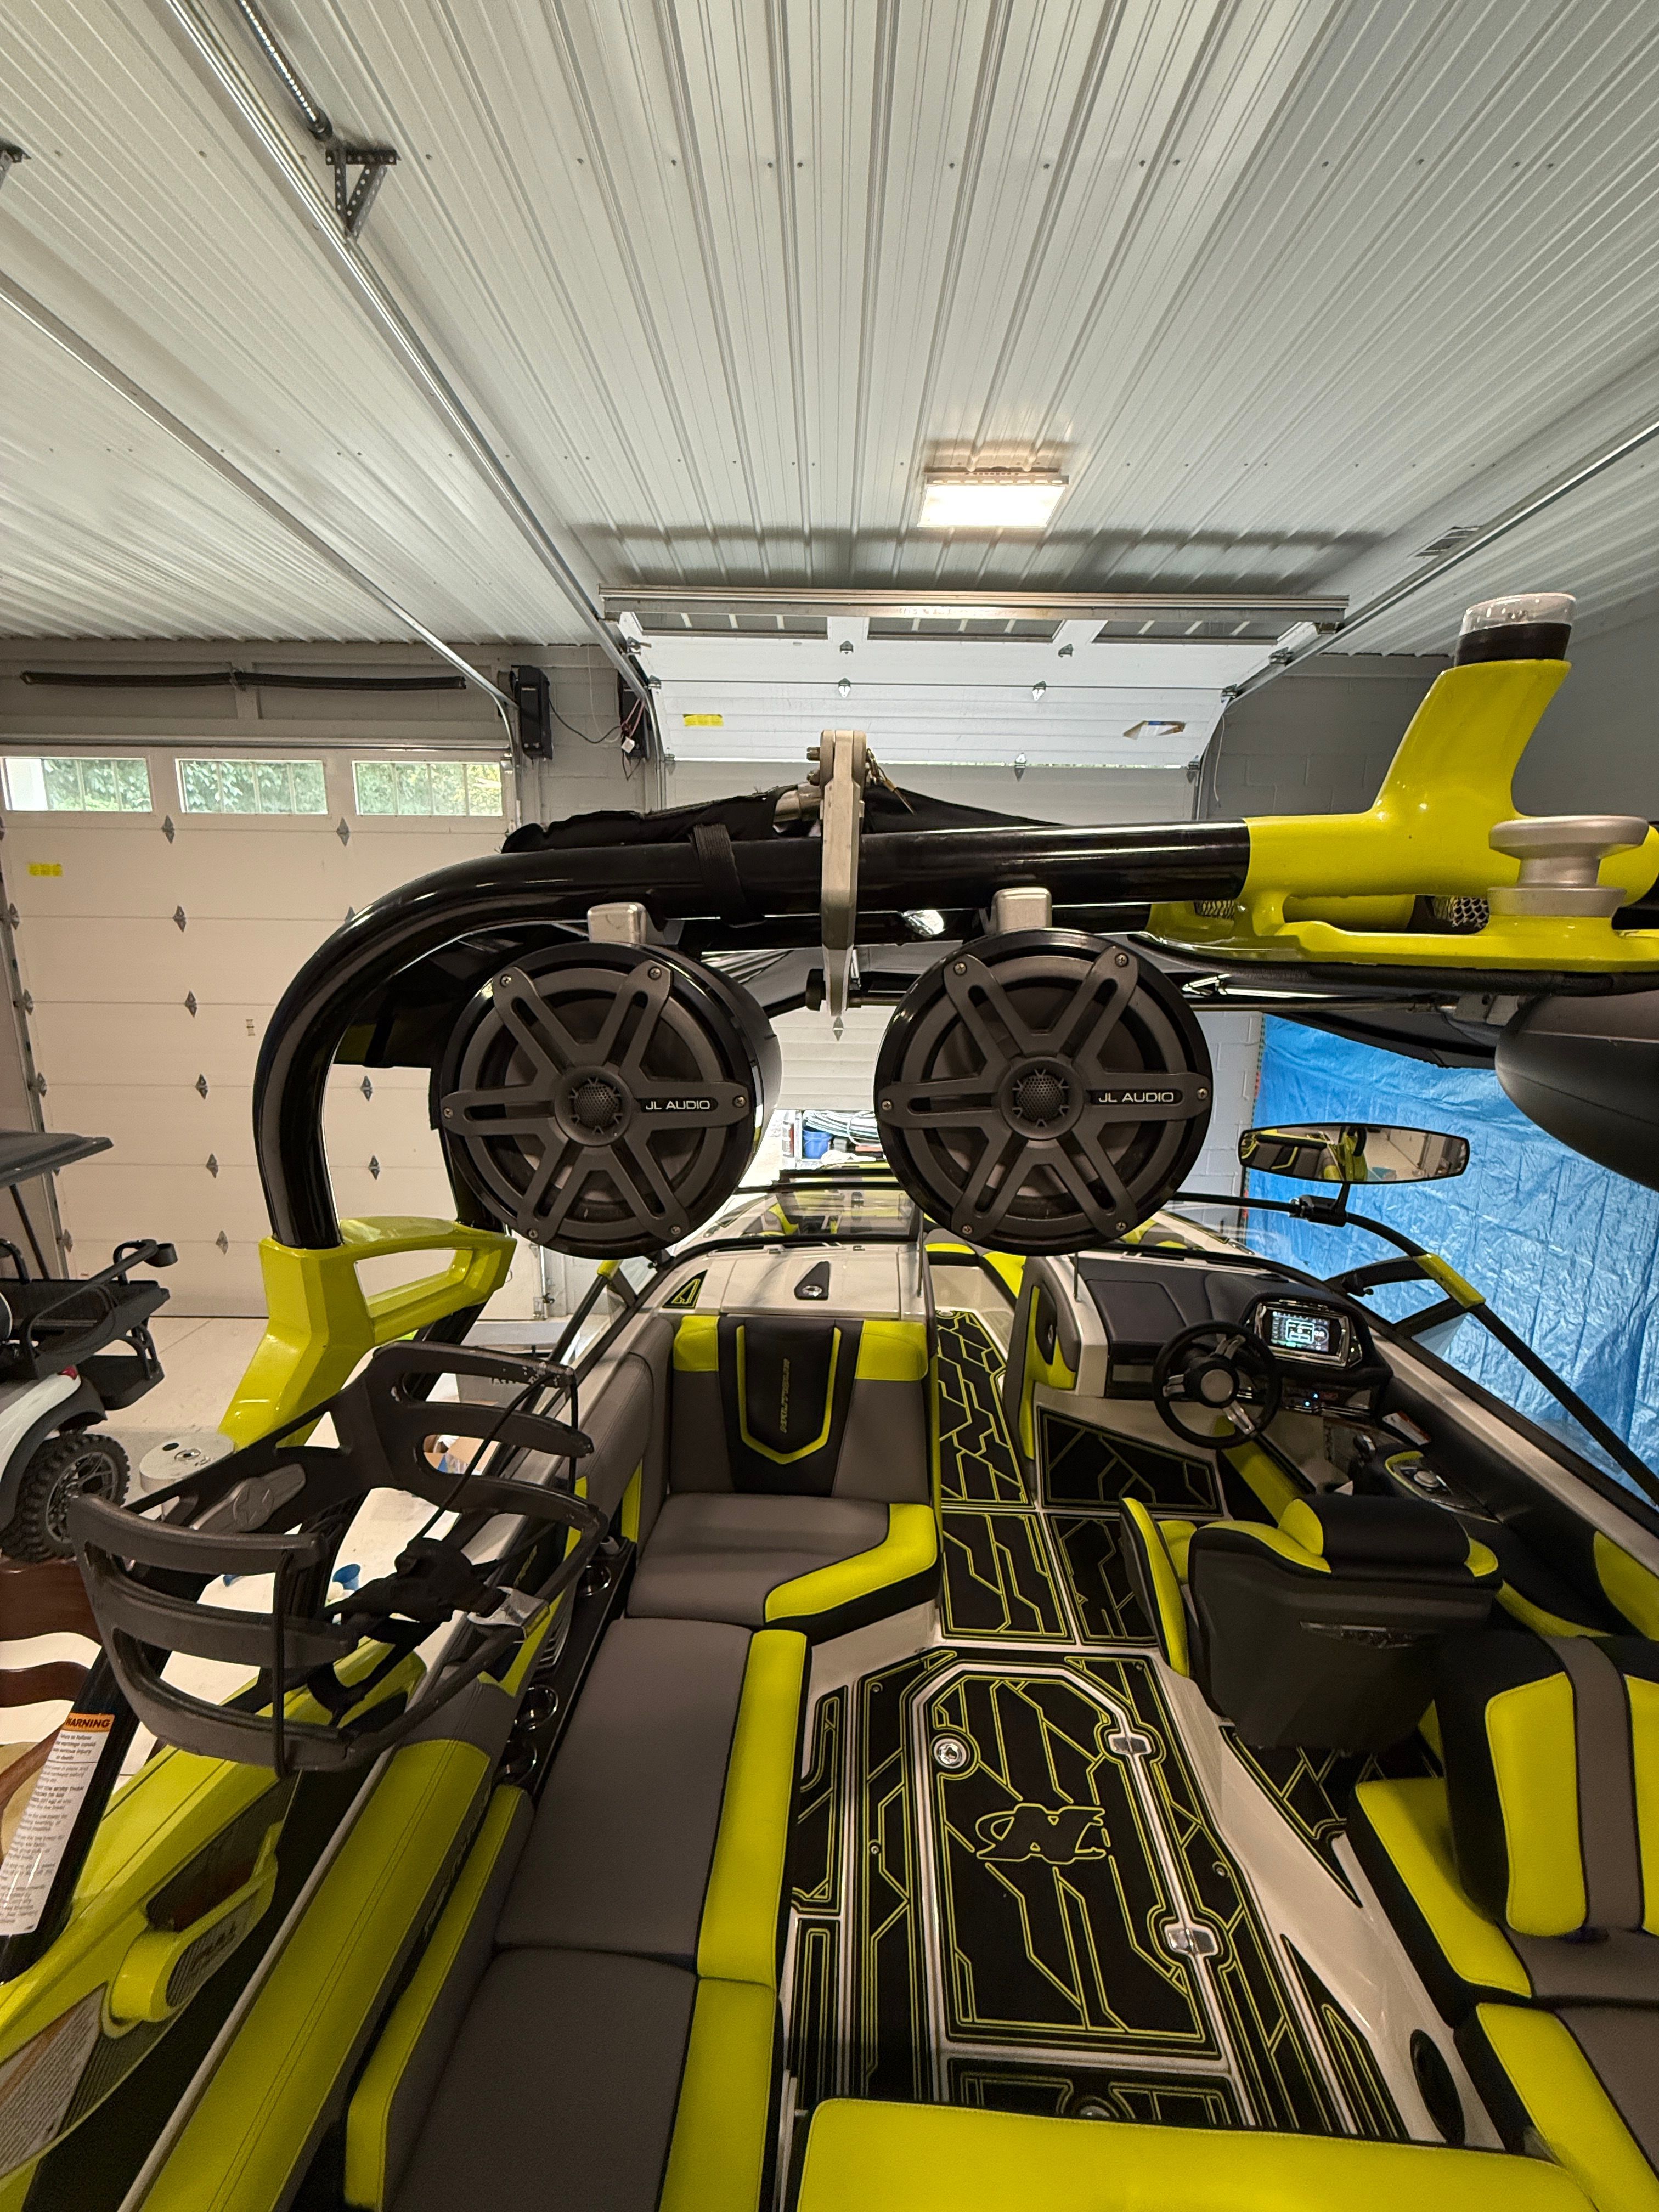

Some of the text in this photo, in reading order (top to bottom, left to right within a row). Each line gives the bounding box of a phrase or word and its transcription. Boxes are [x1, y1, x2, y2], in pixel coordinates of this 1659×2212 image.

[1098, 1092, 1174, 1102] JL AUDIO
[645, 1100, 710, 1110] JL AUDIO
[65, 1718, 110, 1728] WARNING
